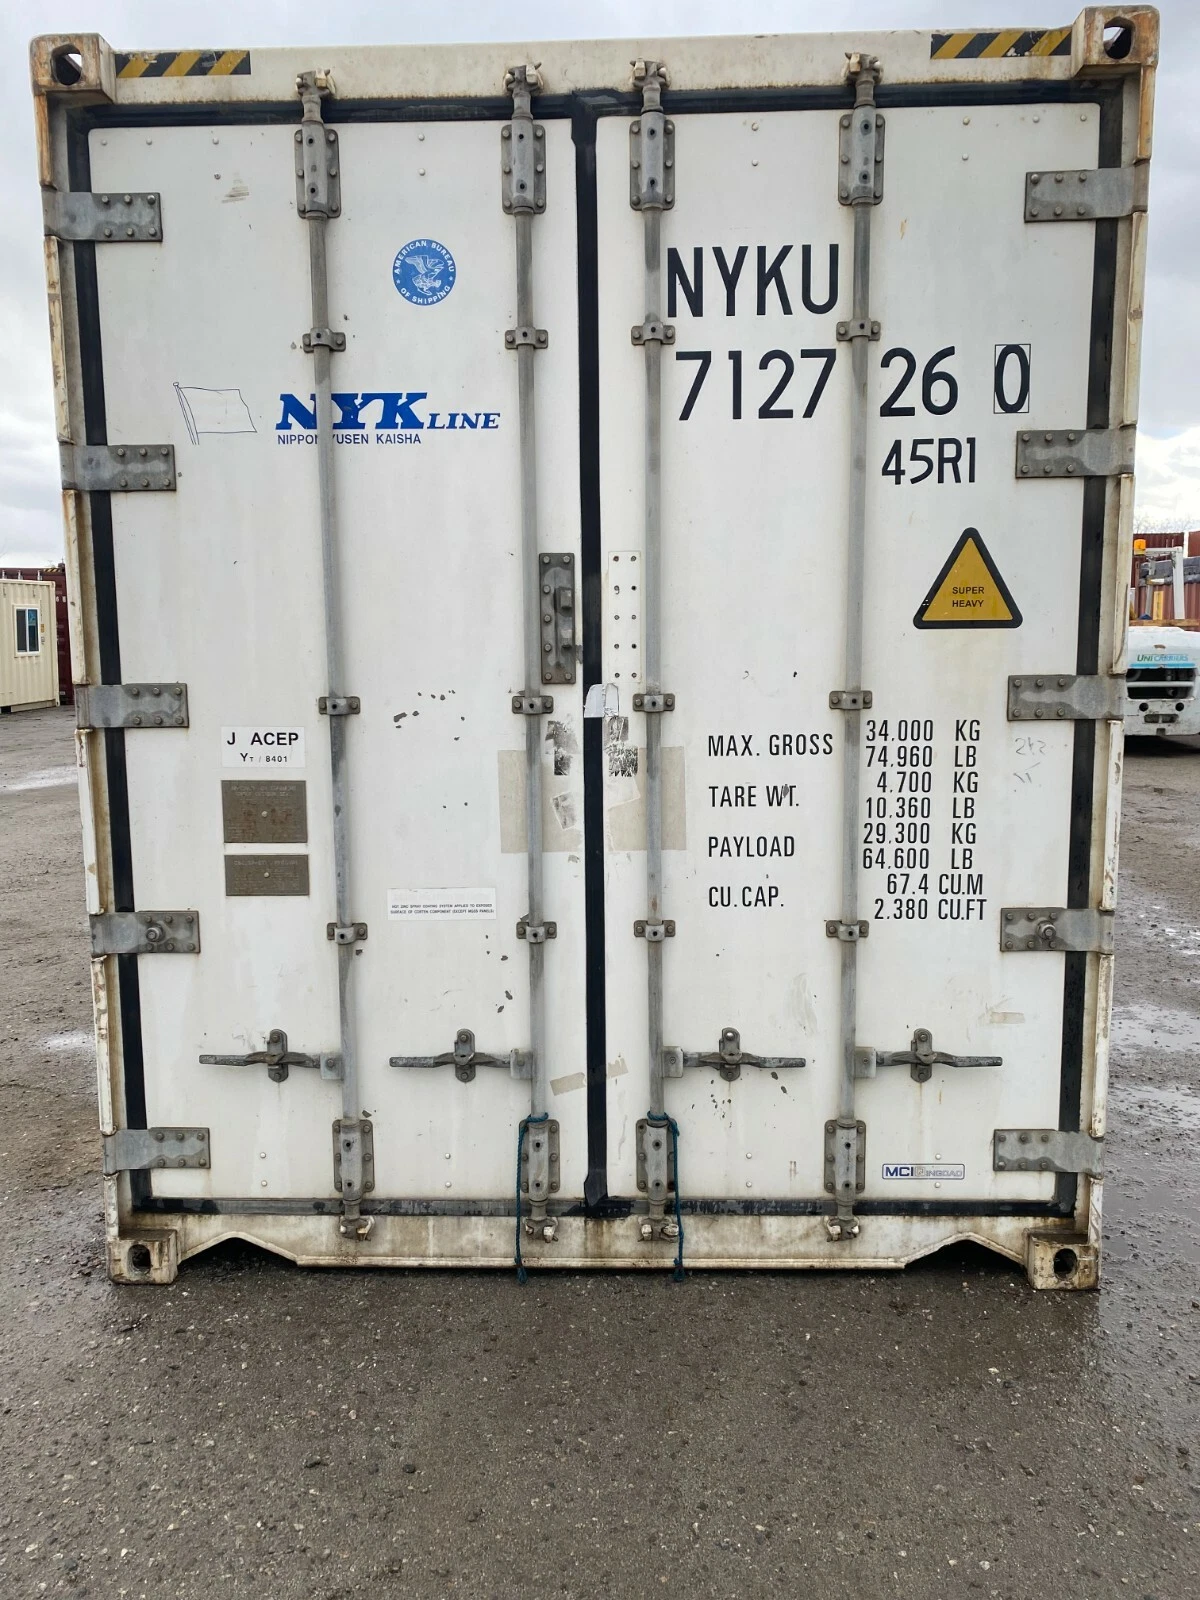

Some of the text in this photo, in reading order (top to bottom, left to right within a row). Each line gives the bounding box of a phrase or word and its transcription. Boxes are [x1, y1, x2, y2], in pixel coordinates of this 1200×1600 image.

[394, 240, 455, 275] AMERICAN BUREAU
[667, 243, 839, 318] NYKU
[400, 285, 451, 304] OF SHIPPING
[994, 344, 1031, 414] 0
[275, 392, 501, 430] NYK LINE
[376, 433, 422, 444] KAISHA
[881, 437, 976, 485] 45R1
[952, 586, 985, 595] SUPER
[952, 599, 984, 608] HEAVY
[227, 732, 299, 745] J ACEP
[865, 719, 981, 742] 34.000 KG
[707, 733, 834, 757] MAX. GROSS
[865, 745, 977, 767] 74.960 LB
[265, 755, 288, 763] 8401
[876, 771, 979, 793] 4.700 KG
[708, 784, 800, 808] TARE WT.
[866, 797, 976, 819] 10.360 LB
[863, 823, 977, 845] 29.300 KG
[708, 836, 795, 858] PAYLOAD
[862, 848, 974, 870] 64.600 LB
[886, 873, 984, 895] 67.4 CU.M
[874, 898, 988, 920] 2.380 CU.FT
[885, 1167, 914, 1177] MCI
